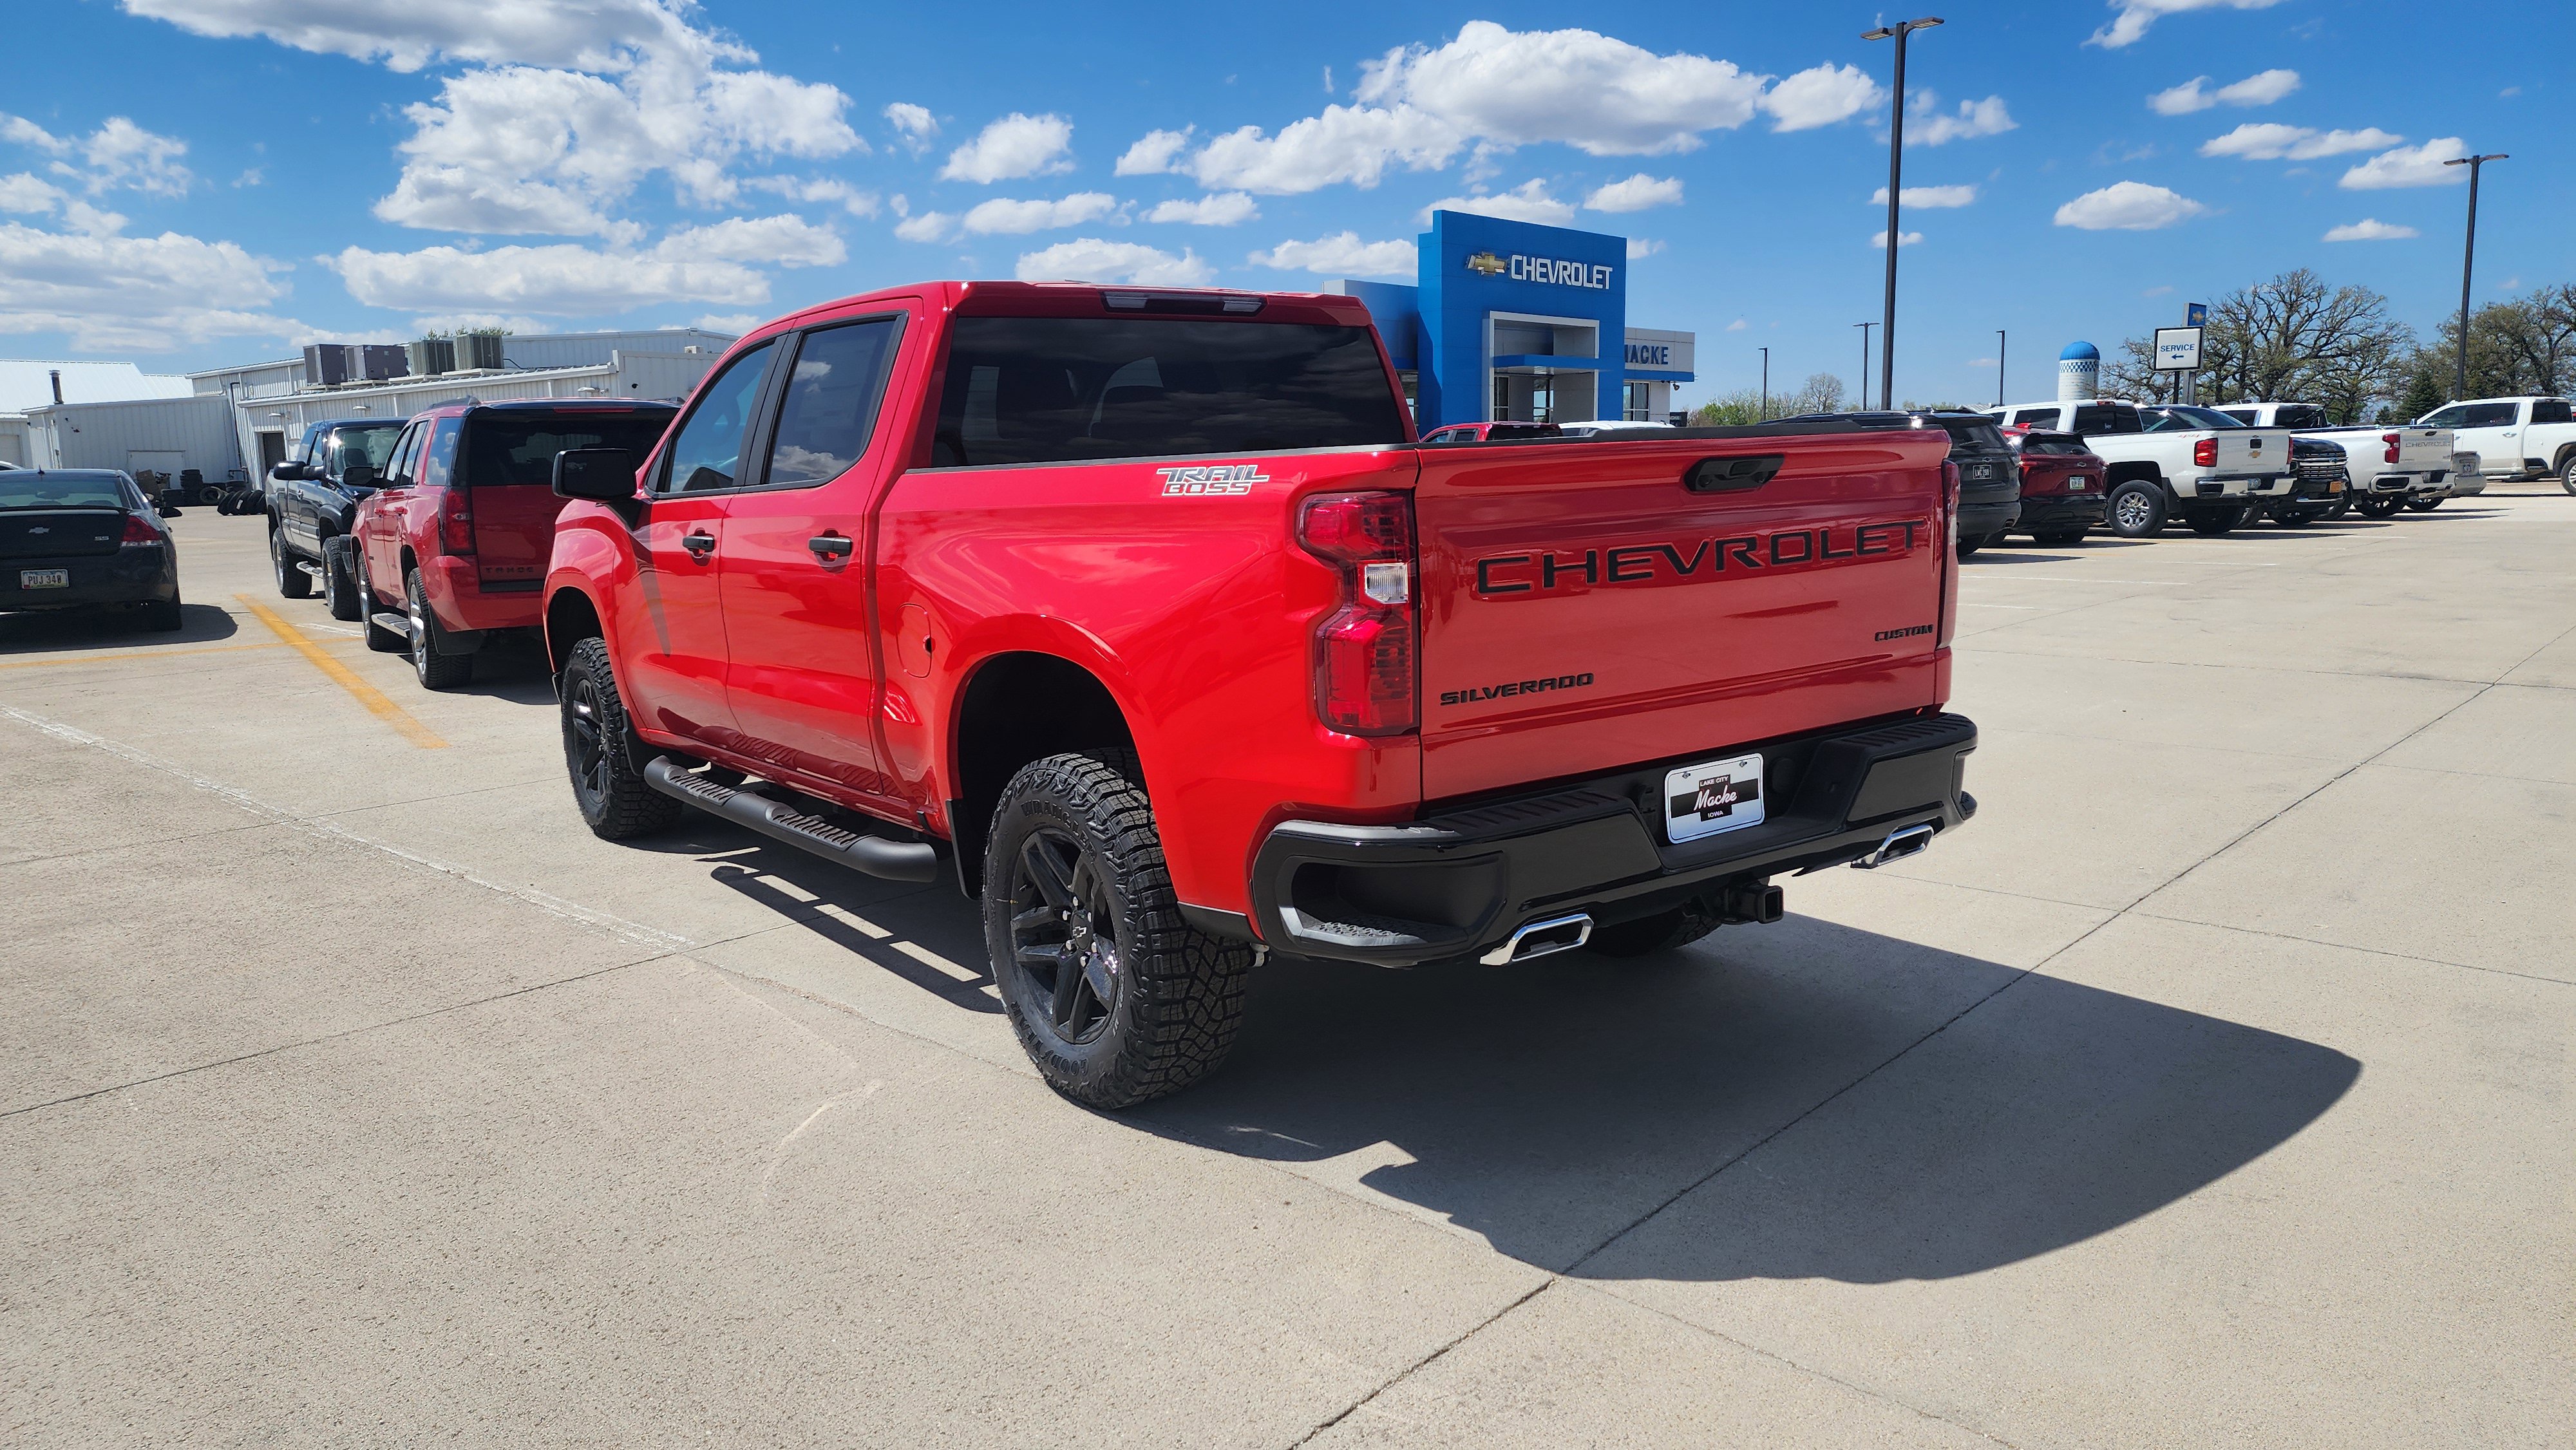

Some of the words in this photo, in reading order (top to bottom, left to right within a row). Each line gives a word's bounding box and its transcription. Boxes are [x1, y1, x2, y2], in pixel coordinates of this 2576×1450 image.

[1511, 254, 1613, 290] CHEVROLET
[2160, 344, 2195, 352] SERVICE
[1156, 465, 1270, 483] TRAIL
[1162, 482, 1252, 496] BOSS
[1477, 519, 1925, 594] CHEVROLET
[28, 575, 43, 585] PUJ
[1875, 624, 1934, 642] CUSTOM
[1440, 672, 1595, 706] SILVERADO
[1700, 778, 1715, 787] LAKE
[1716, 775, 1729, 784] CITY
[1693, 784, 1738, 811] Macke
[1707, 810, 1724, 818] IOWA
[1010, 1001, 1089, 1077] GOODYEAR
